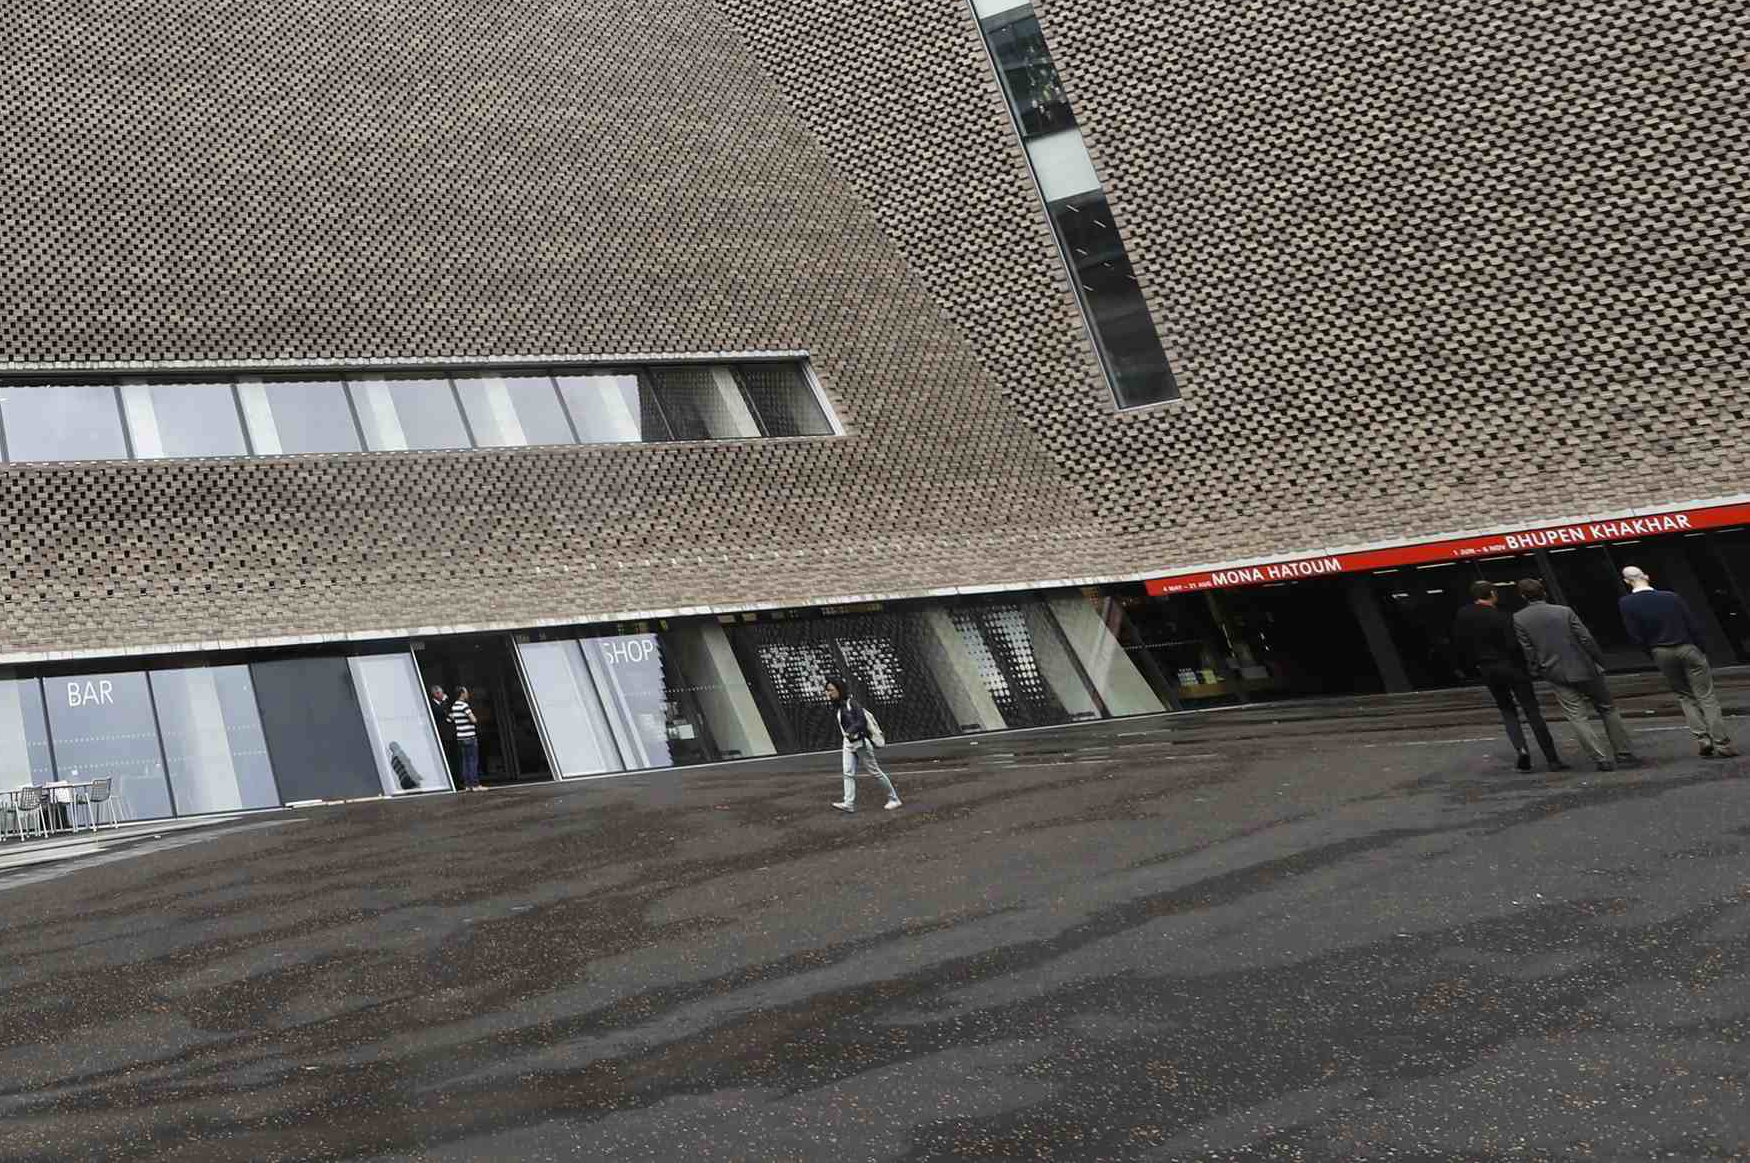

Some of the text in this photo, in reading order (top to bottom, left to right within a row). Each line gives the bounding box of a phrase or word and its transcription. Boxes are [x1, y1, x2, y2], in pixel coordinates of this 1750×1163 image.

[1504, 527, 1586, 550] BHUPEN
[1591, 513, 1691, 539] KHAKHAR
[1210, 568, 1264, 586] MONA
[1266, 557, 1343, 580] HATOUM
[601, 639, 654, 664] SHOP
[67, 679, 114, 706] BAR
